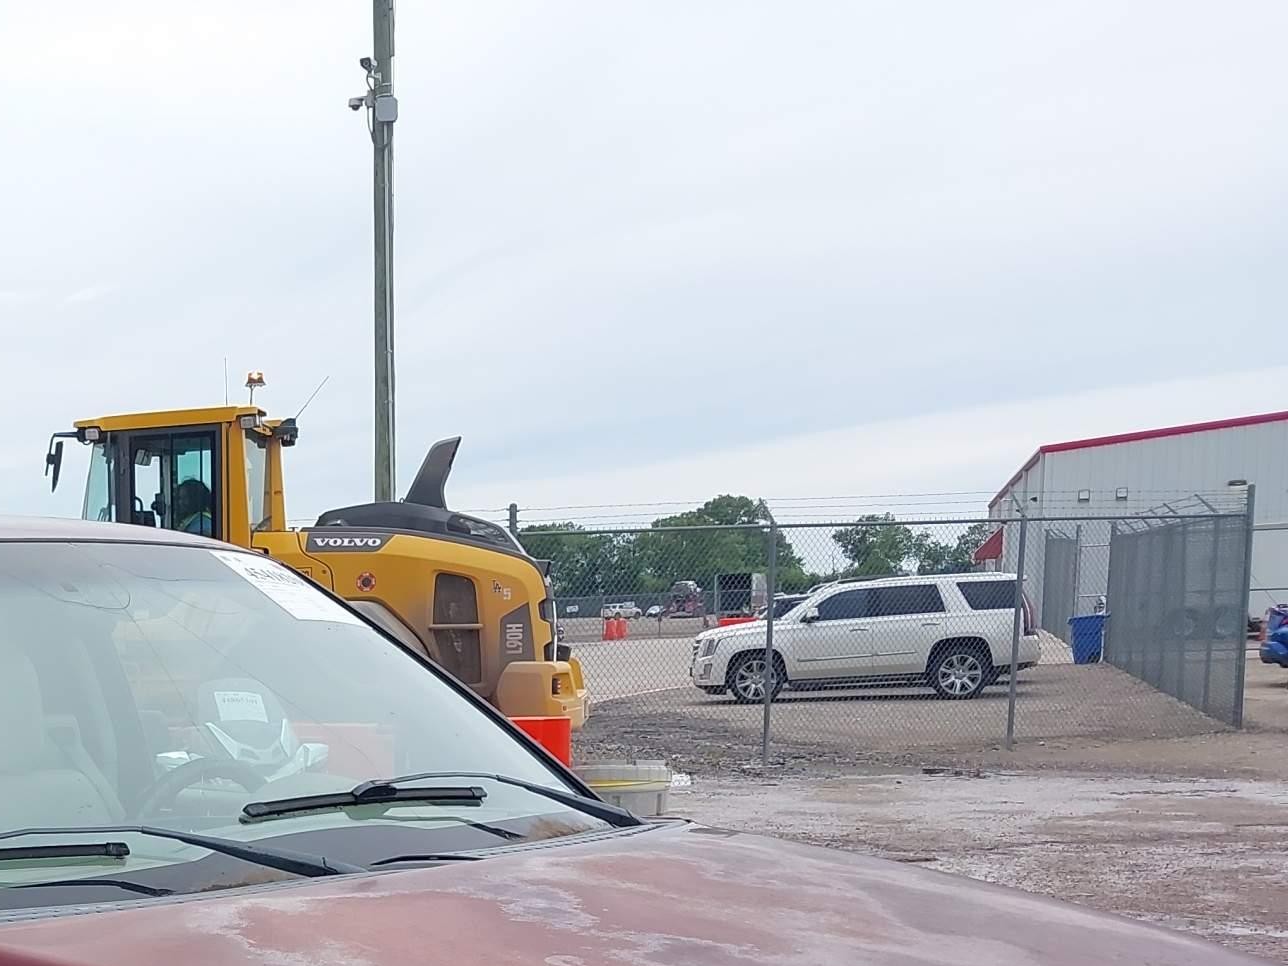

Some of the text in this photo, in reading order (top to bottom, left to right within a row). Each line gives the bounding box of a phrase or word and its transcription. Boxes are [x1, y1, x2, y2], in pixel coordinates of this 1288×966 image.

[314, 537, 381, 547] VOLVO
[503, 587, 511, 600] 5
[506, 623, 523, 655] L90H
